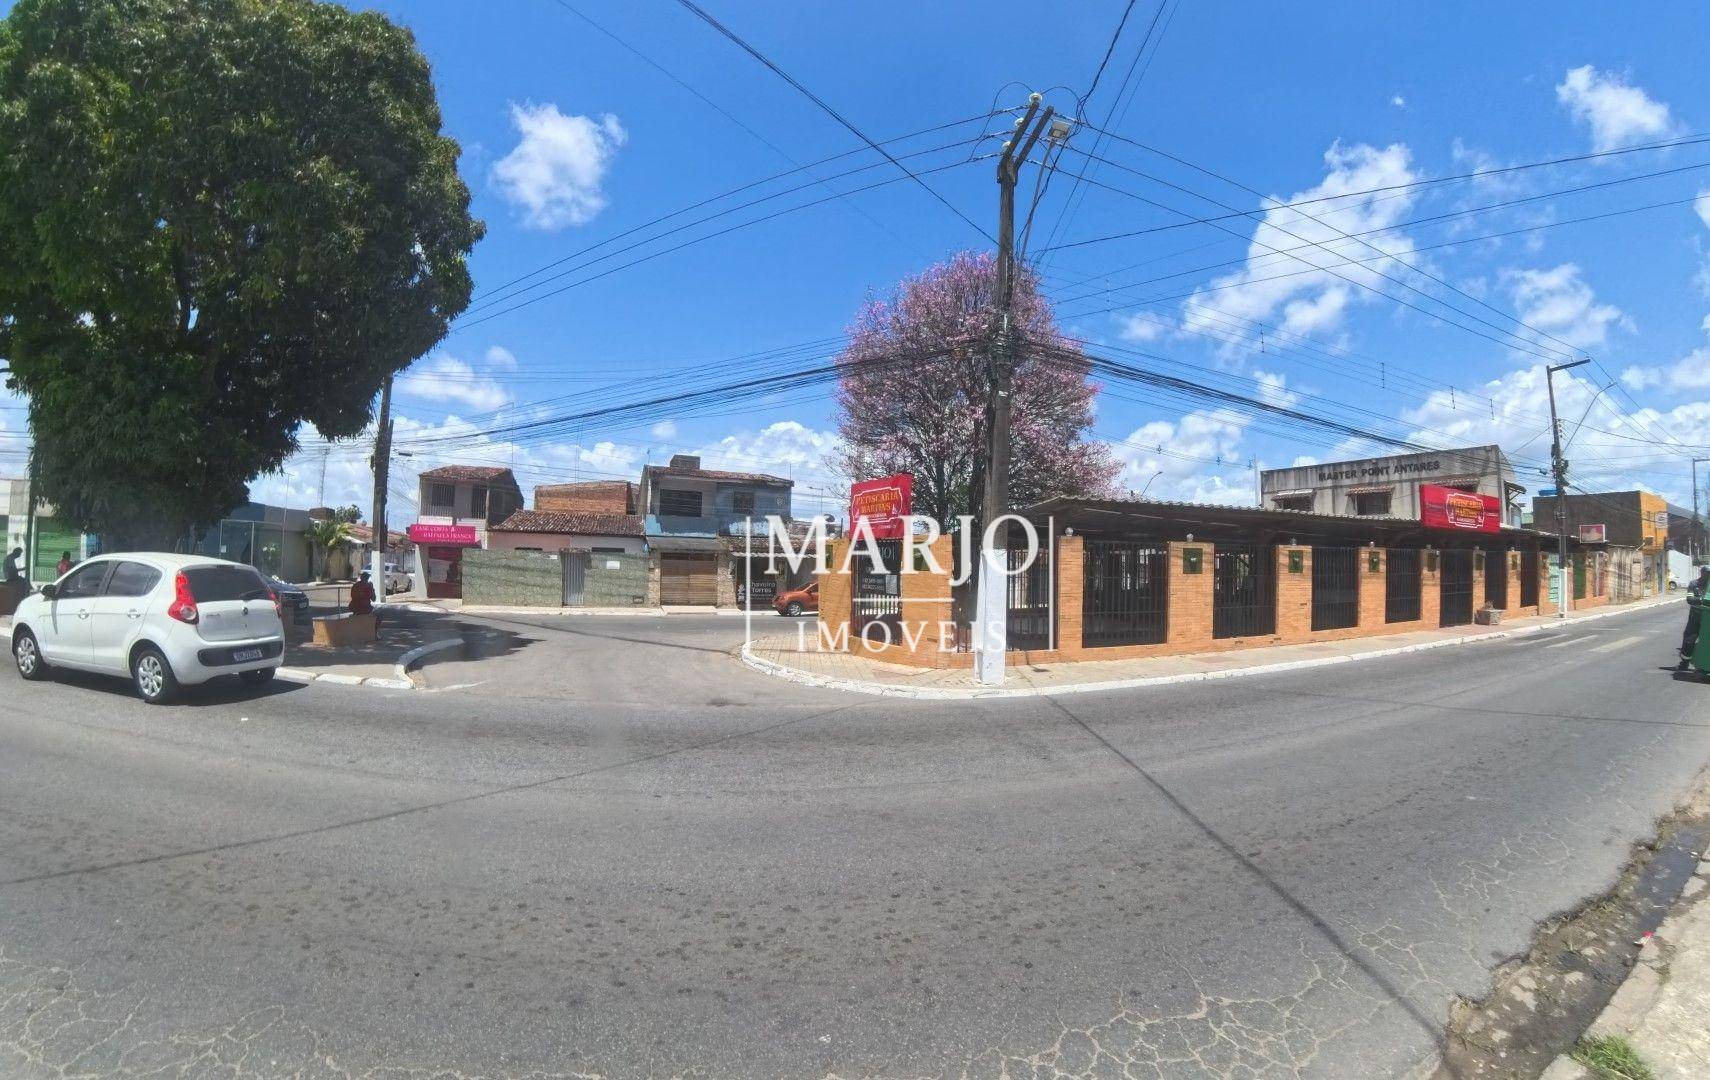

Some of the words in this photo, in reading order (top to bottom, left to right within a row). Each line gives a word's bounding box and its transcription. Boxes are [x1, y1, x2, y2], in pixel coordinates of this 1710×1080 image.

[1318, 469, 1357, 481] MASTER
[1361, 466, 1390, 478] POINT
[1394, 460, 1440, 474] ANTARES
[856, 491, 899, 505] PETISCARIA
